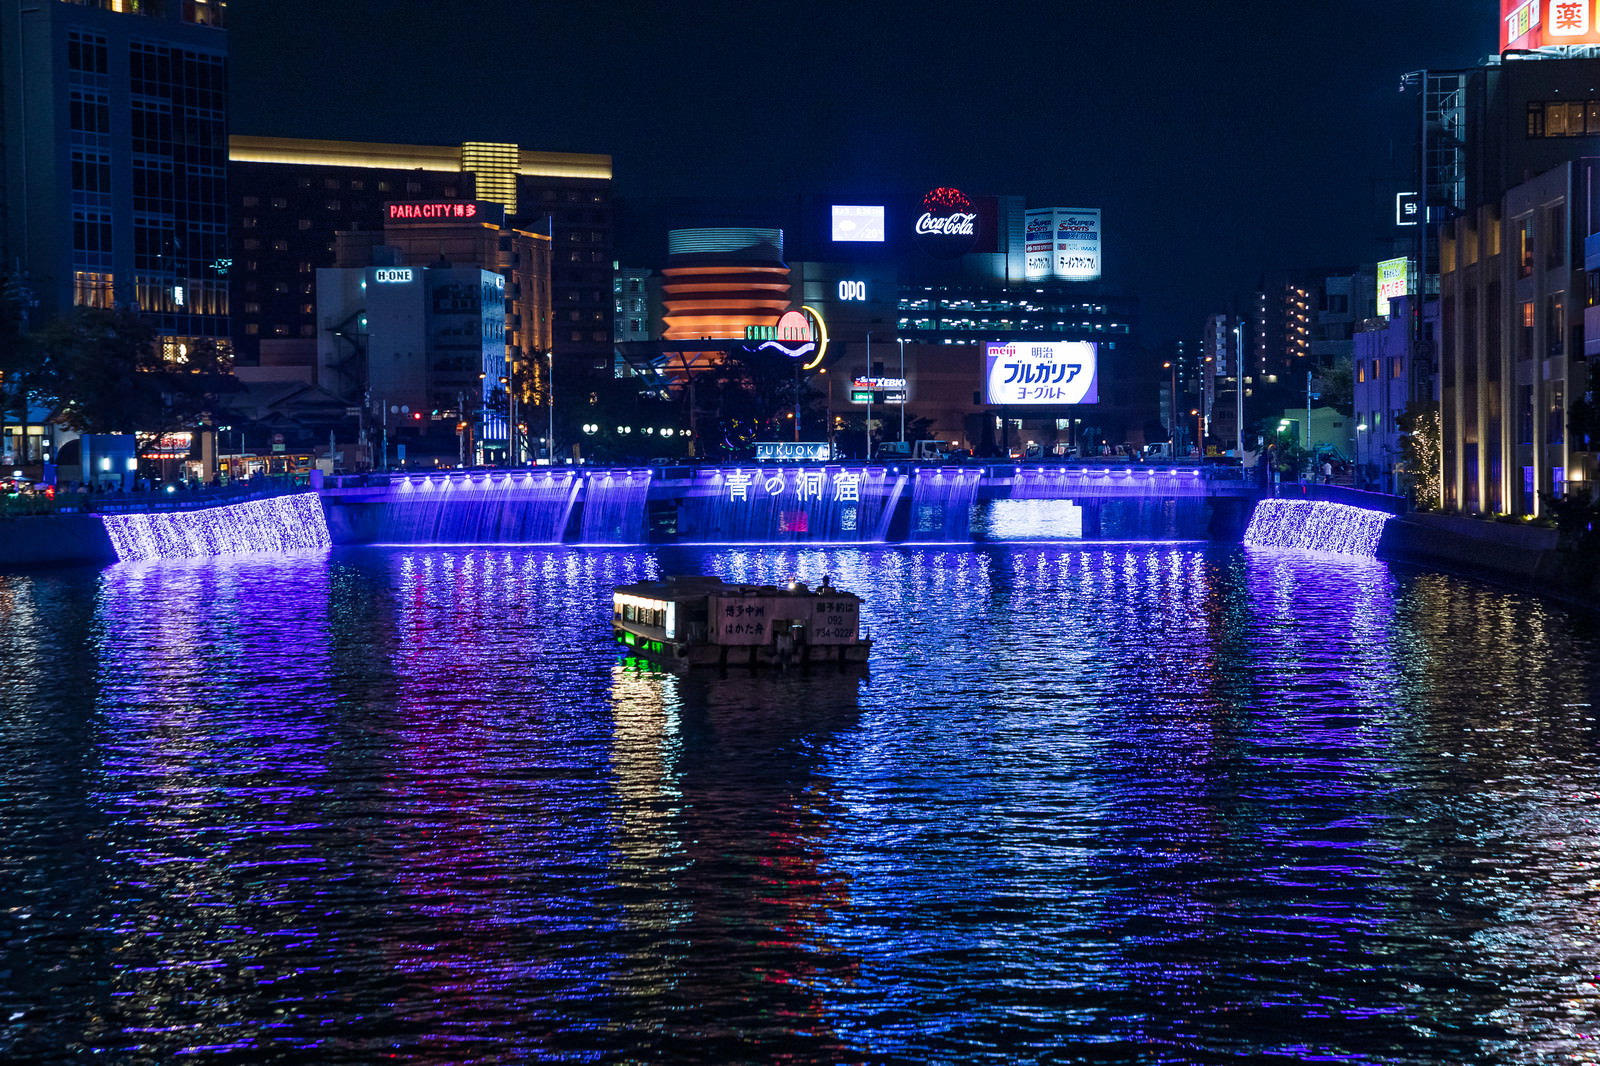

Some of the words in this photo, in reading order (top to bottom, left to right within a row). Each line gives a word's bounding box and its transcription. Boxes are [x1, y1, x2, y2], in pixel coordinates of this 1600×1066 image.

[1556, 3, 1582, 29] 薬
[915, 212, 977, 235] Coca-Cola
[747, 325, 779, 341] CANAL
[784, 326, 807, 341] CITY
[989, 345, 1016, 357] meiji
[1031, 346, 1053, 358] 明治
[1004, 360, 1082, 384] ブルガリア
[1017, 385, 1066, 400] ヨーグルト
[724, 470, 861, 502] 青の洞窟
